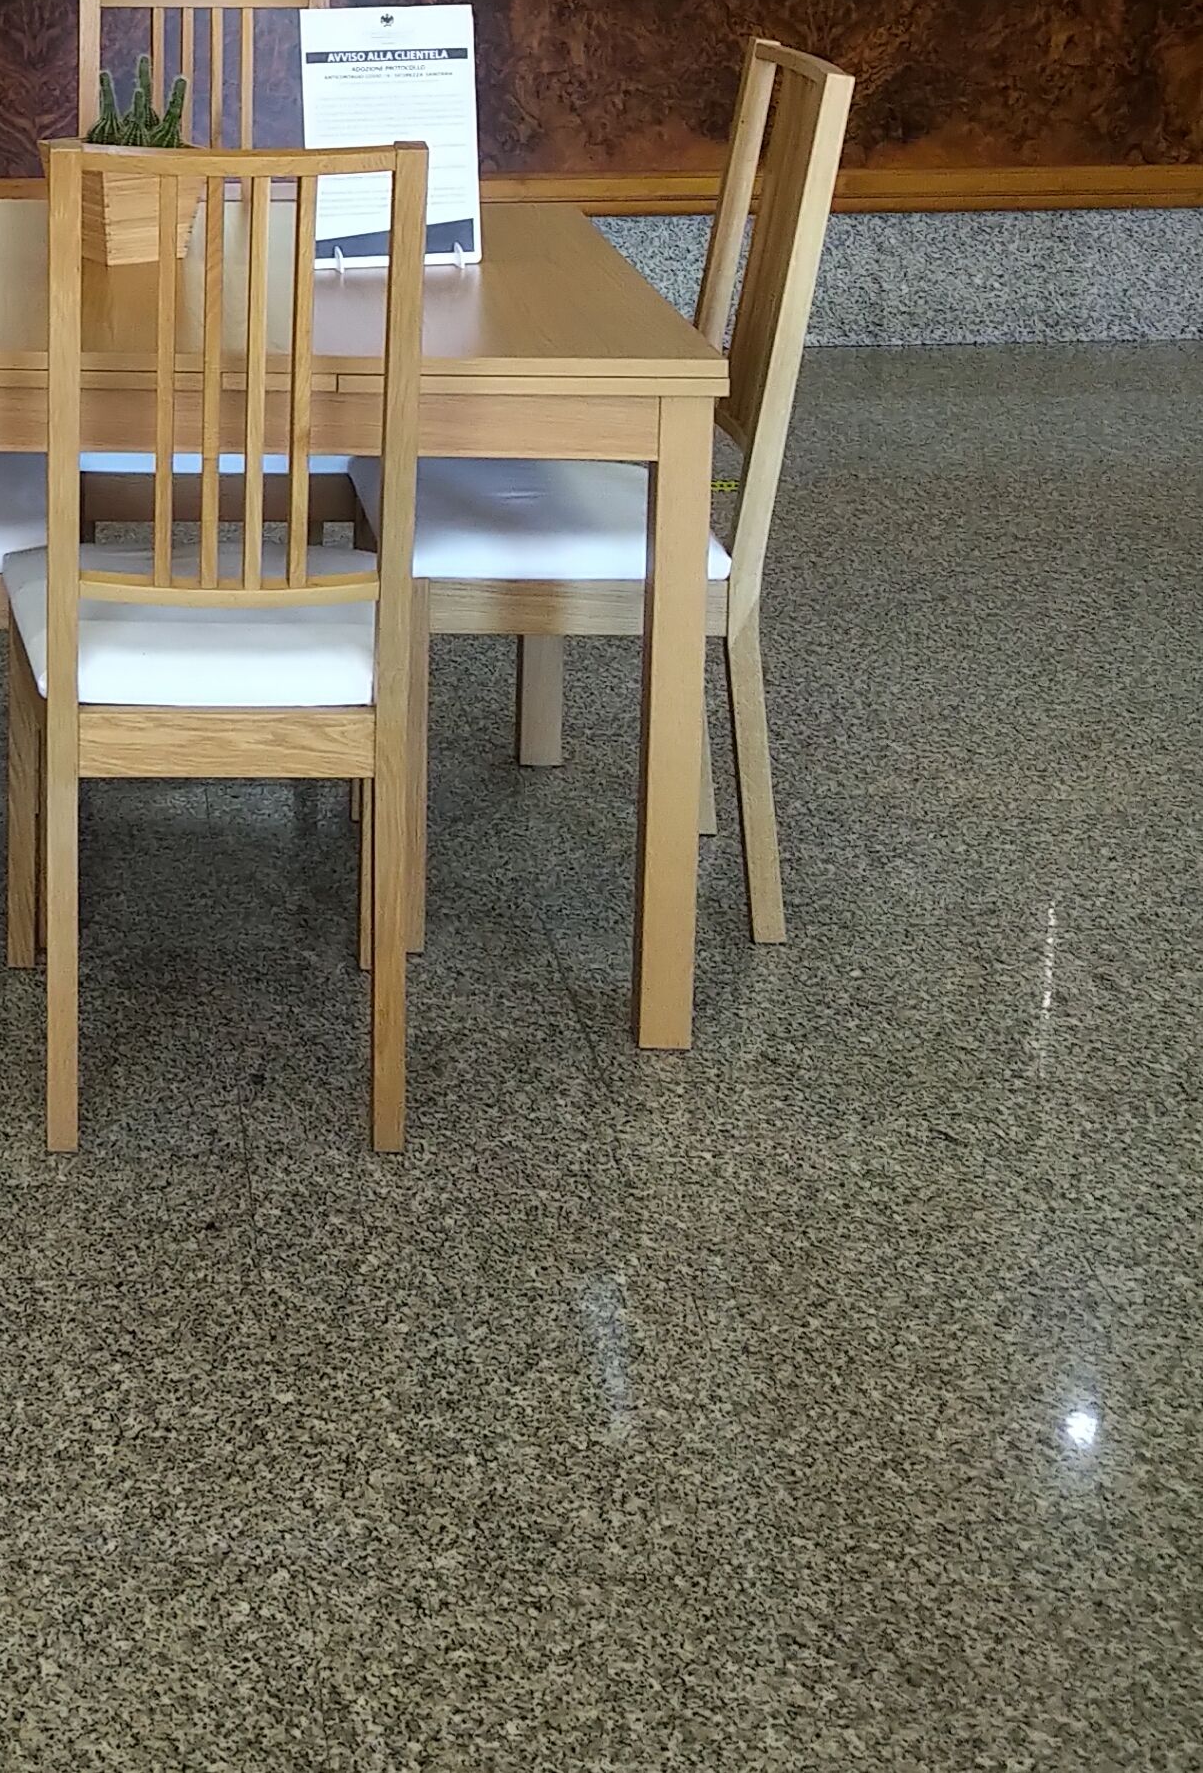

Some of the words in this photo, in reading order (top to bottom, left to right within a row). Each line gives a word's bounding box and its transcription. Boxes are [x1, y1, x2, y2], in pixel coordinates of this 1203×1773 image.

[327, 52, 365, 63] AVVISO
[367, 51, 393, 61] ALLA
[395, 49, 449, 60] CLIENTELA
